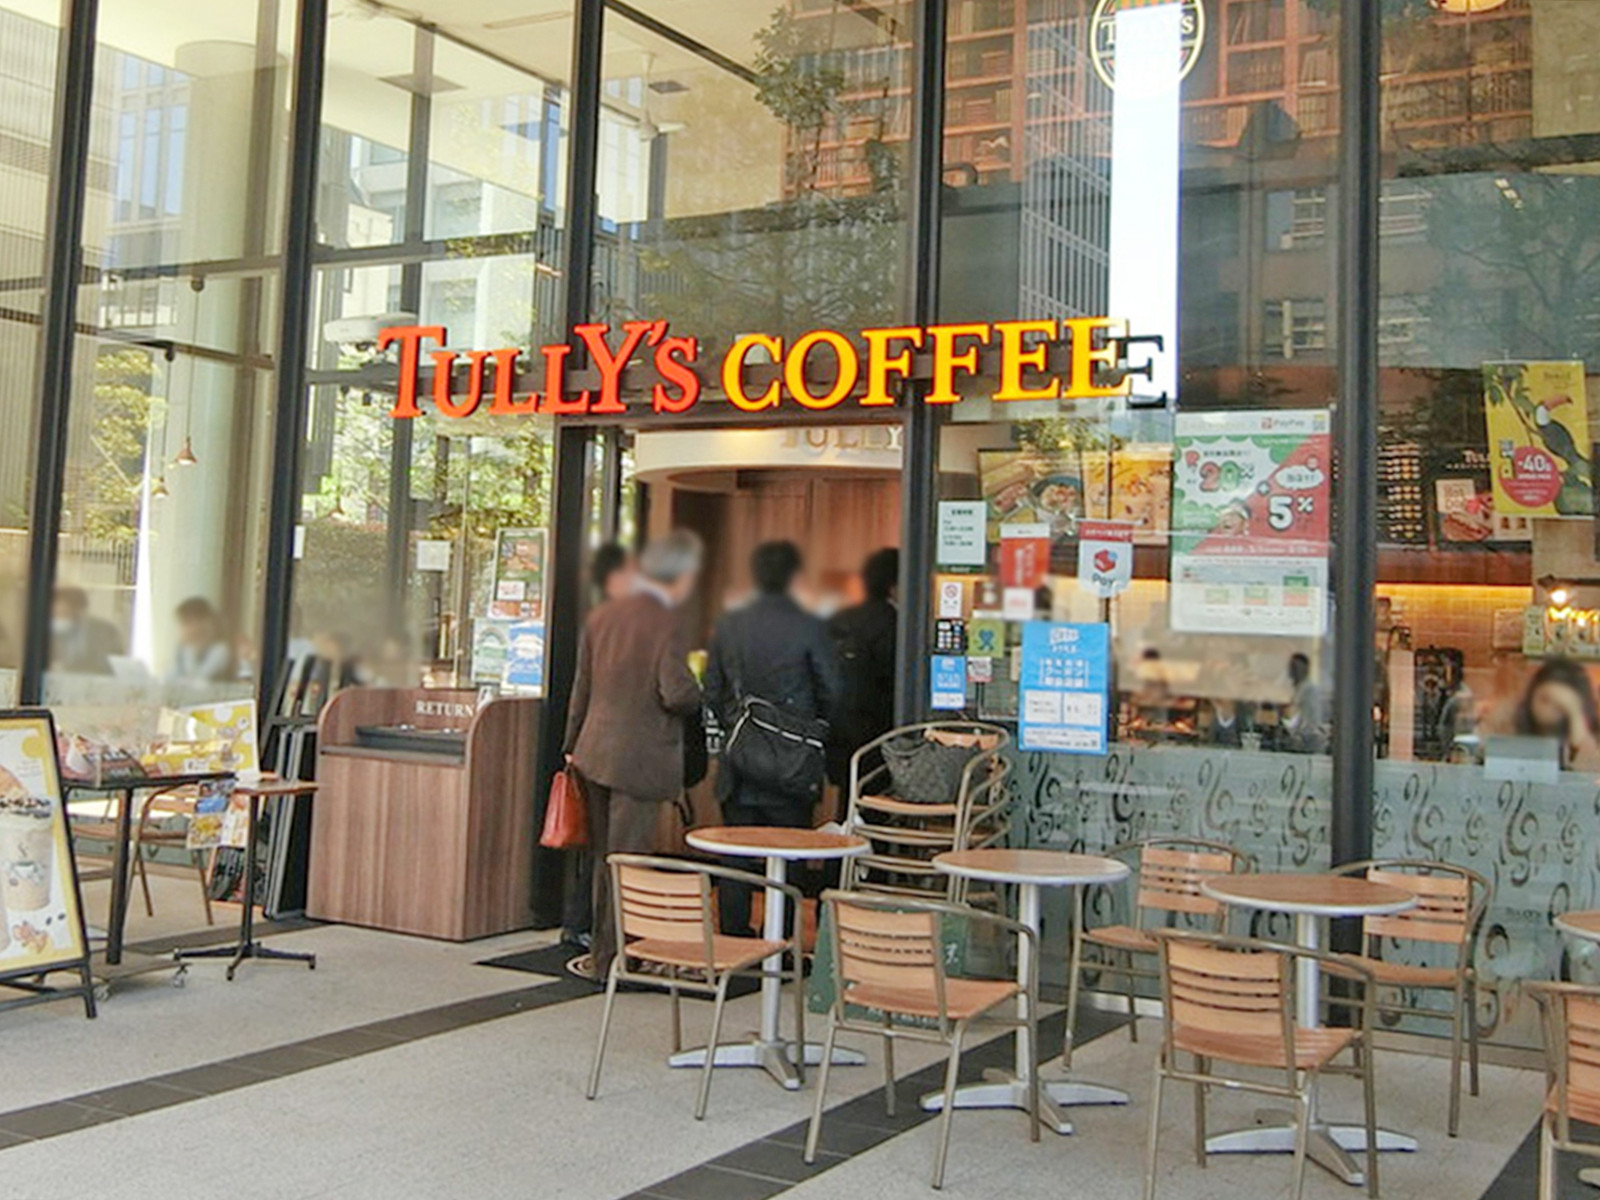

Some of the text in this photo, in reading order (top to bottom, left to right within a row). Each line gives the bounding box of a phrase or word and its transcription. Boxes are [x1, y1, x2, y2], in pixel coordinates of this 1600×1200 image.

[378, 316, 1134, 419] TULLY'S COFFEE
[1268, 494, 1314, 531] 5%
[415, 700, 475, 717] RETURN
